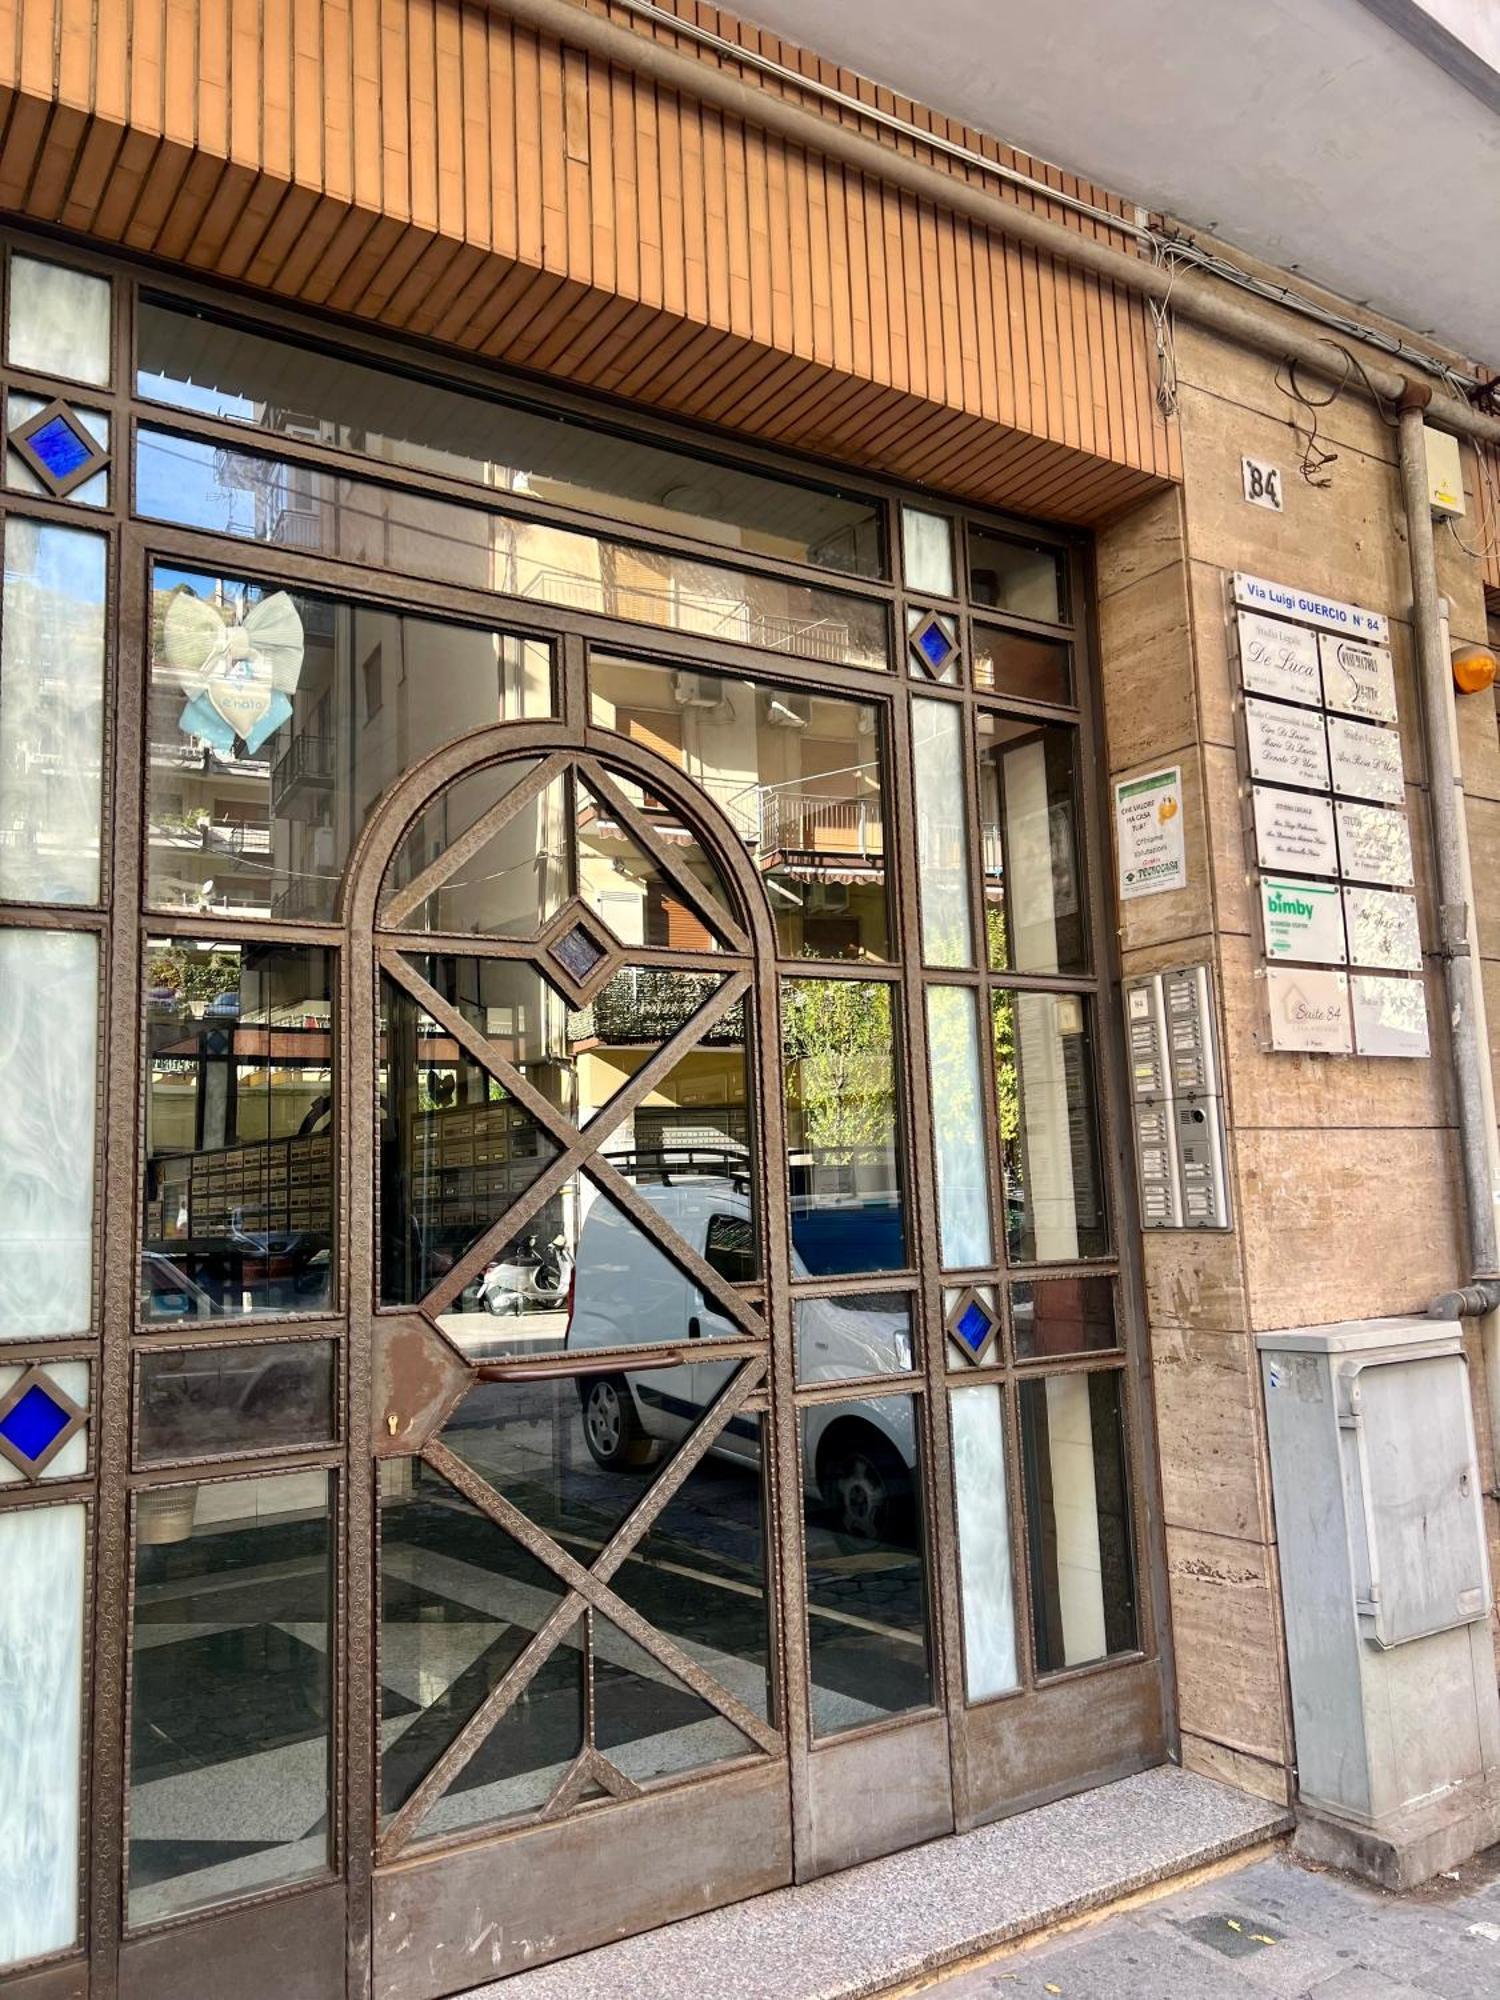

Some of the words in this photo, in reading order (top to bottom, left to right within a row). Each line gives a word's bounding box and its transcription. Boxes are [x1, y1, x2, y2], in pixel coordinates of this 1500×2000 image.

[1250, 466, 1277, 502] 84
[1247, 583, 1265, 599] Via
[1269, 590, 1296, 608] Luigi
[1299, 599, 1347, 622] GUERCIO
[1367, 618, 1379, 631] 84
[1247, 640, 1272, 665] De
[1274, 648, 1315, 678] Luca
[1268, 892, 1313, 920] bimby
[1326, 1005, 1341, 1021] 84
